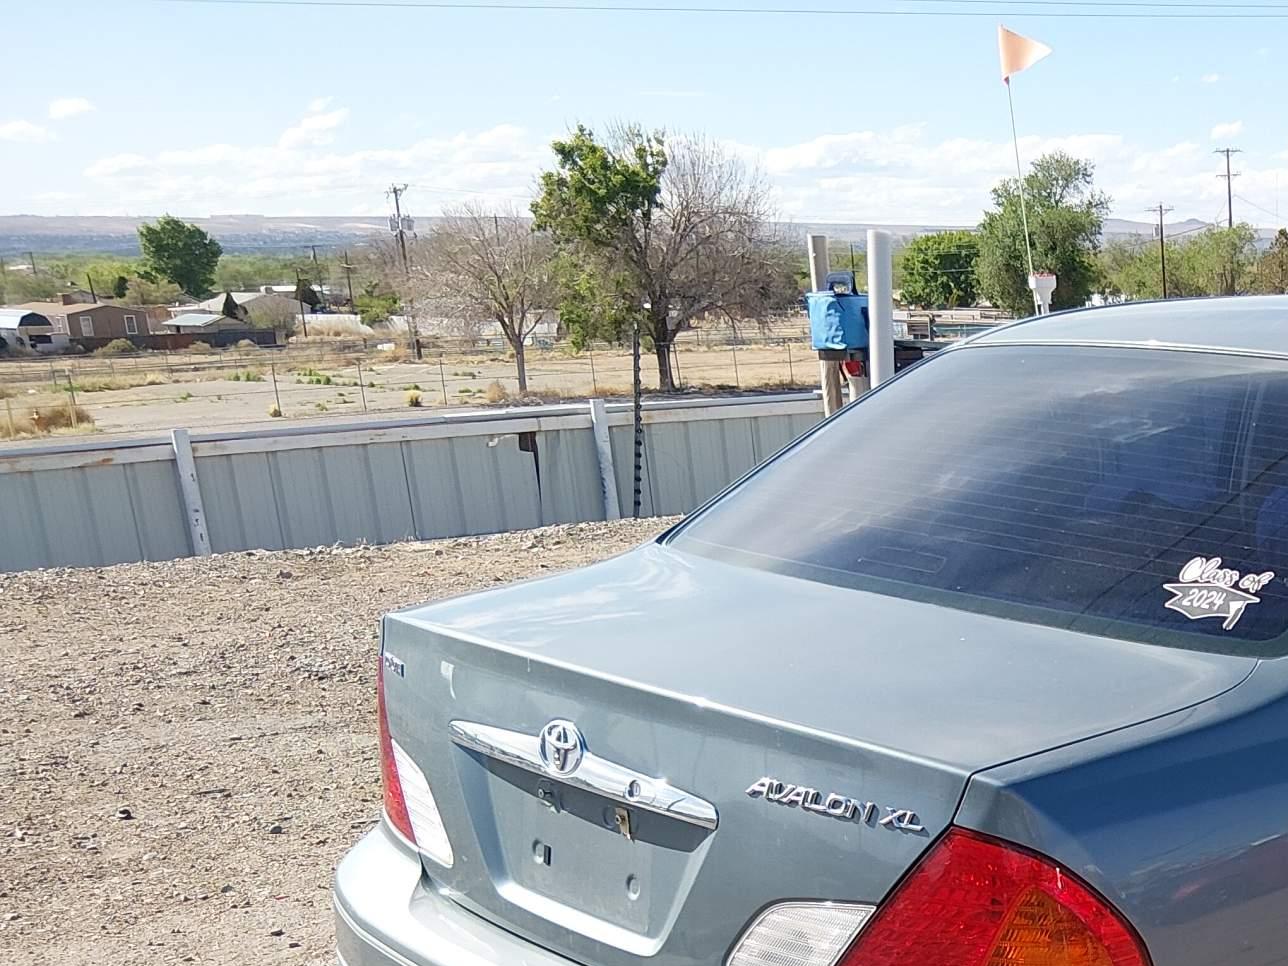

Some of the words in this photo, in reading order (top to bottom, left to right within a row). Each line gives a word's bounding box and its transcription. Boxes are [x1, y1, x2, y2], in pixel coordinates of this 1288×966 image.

[1179, 556, 1239, 586] Class
[1239, 571, 1275, 593] of
[1182, 588, 1227, 611] 2024
[745, 776, 877, 827] AVALON
[879, 806, 928, 835] XL
